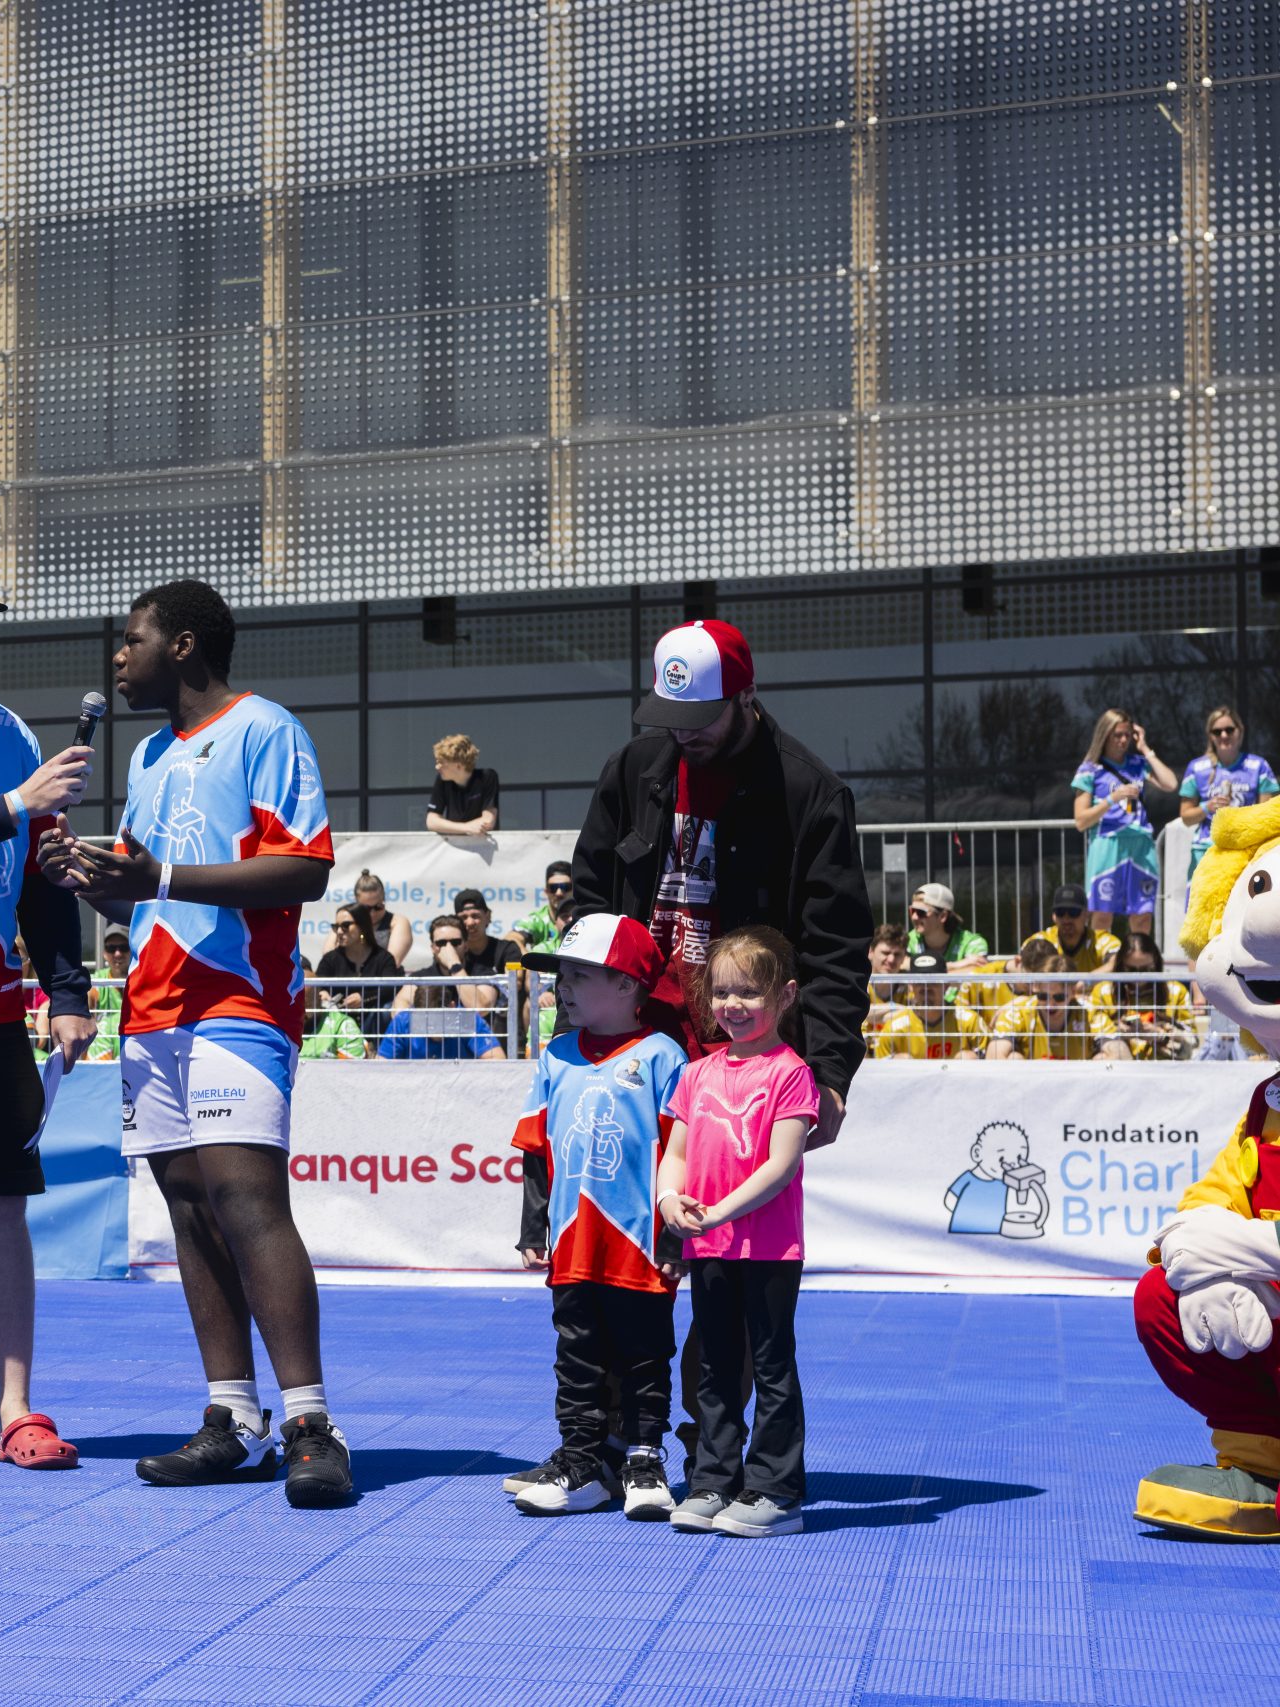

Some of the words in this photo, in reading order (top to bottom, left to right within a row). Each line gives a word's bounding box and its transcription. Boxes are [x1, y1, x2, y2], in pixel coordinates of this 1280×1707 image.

[438, 882, 527, 907] joons
[190, 1088, 246, 1098] POMERLEAU
[197, 1108, 232, 1119] MNM
[1062, 1123, 1199, 1143] Fondation
[289, 1154, 439, 1194] anque
[450, 1143, 524, 1183] Sco
[1060, 1149, 1199, 1192] Charl
[1062, 1196, 1178, 1236] Brun
